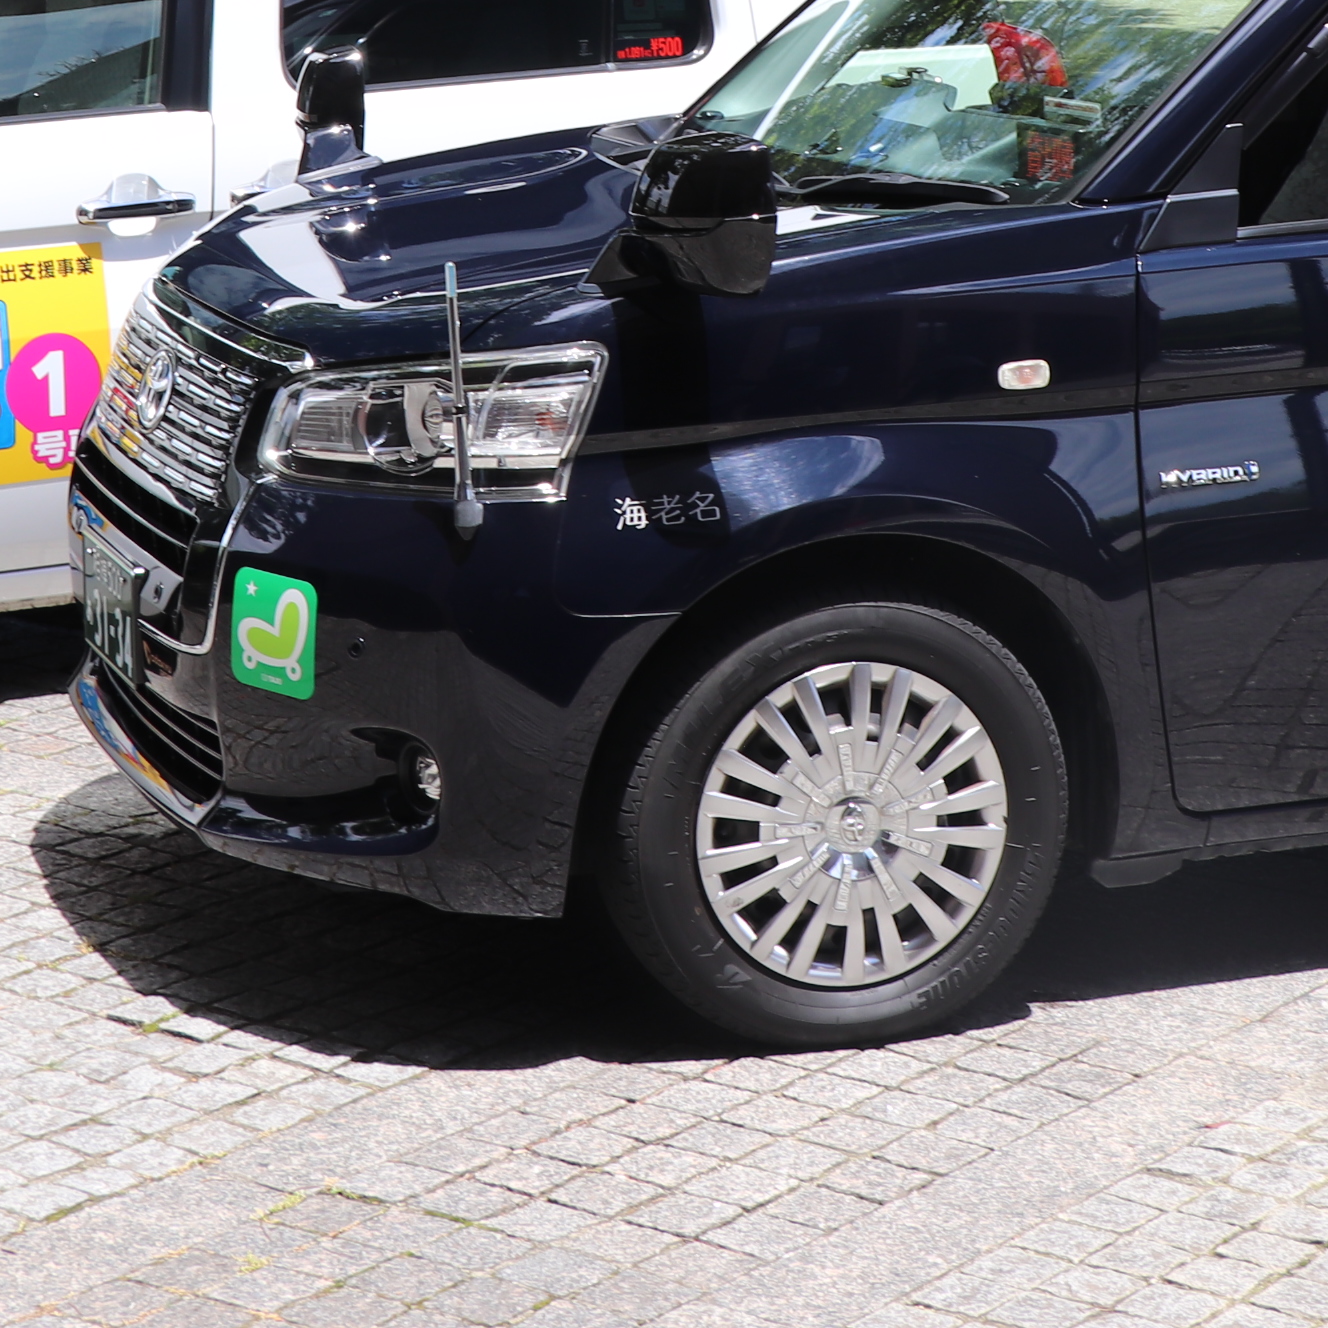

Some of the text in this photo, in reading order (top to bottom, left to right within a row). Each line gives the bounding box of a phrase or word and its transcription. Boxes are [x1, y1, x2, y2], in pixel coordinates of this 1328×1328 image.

[649, 36, 684, 57] ¥500
[31, 349, 67, 418] 1
[1159, 465, 1246, 486] HYBRID
[613, 490, 722, 532] 海老名
